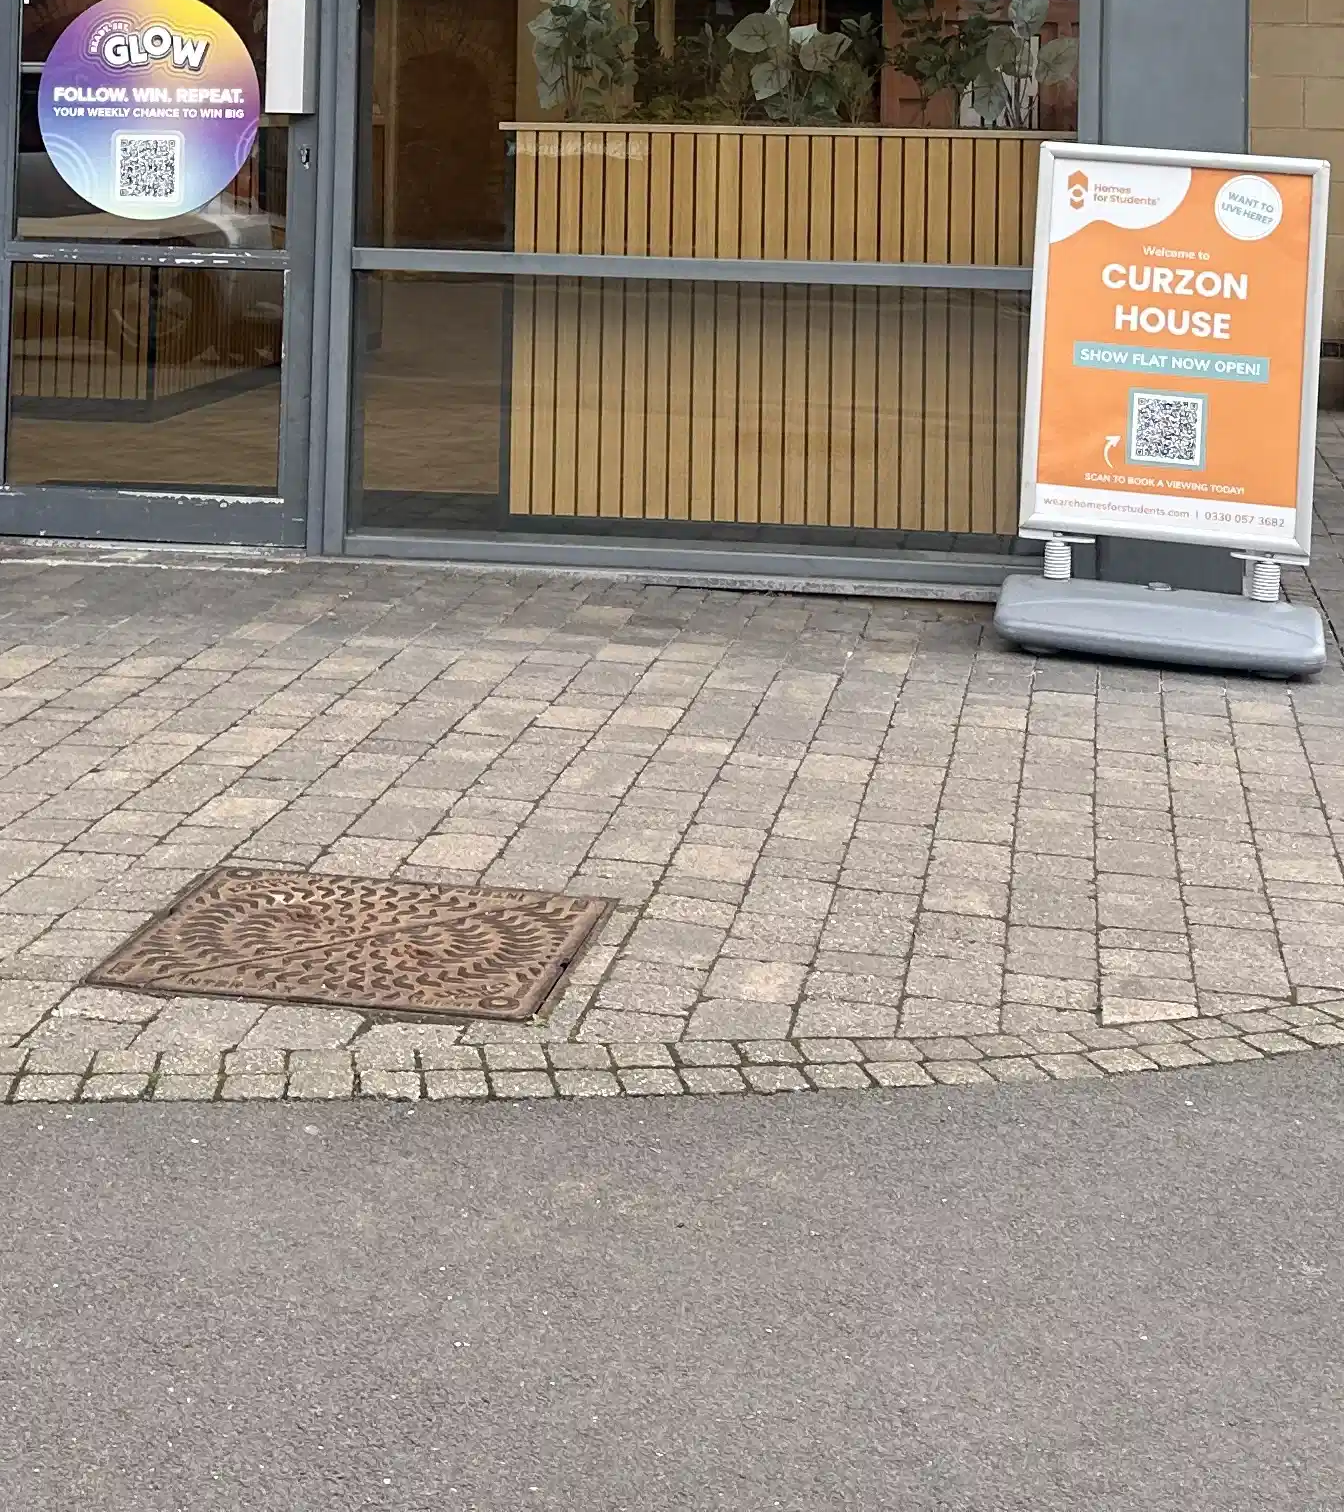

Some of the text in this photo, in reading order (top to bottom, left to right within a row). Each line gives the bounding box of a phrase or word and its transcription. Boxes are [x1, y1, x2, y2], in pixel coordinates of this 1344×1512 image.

[103, 25, 210, 70] GLOW
[53, 87, 244, 104] FOLLOW. WIN. REPEAT.
[53, 107, 245, 119] YOUR WEEKLY CHANCE TO WIN BIG
[1093, 193, 1108, 202] for
[1094, 184, 1132, 194] Homes
[1221, 202, 1274, 224] LIVE HERE?
[1228, 191, 1274, 213] WANT TO
[1142, 245, 1211, 261] Welcome to
[1101, 263, 1248, 300] CURZON
[1114, 304, 1231, 339] HOUSE
[1080, 348, 1261, 376] SHOW FLAT NOW OPEN!
[1084, 472, 1245, 495] SCAN TO BOOK A VIEWING TODAY!
[1205, 511, 1231, 522] 0330
[1234, 514, 1254, 524] 057
[1258, 517, 1285, 528] 3682
